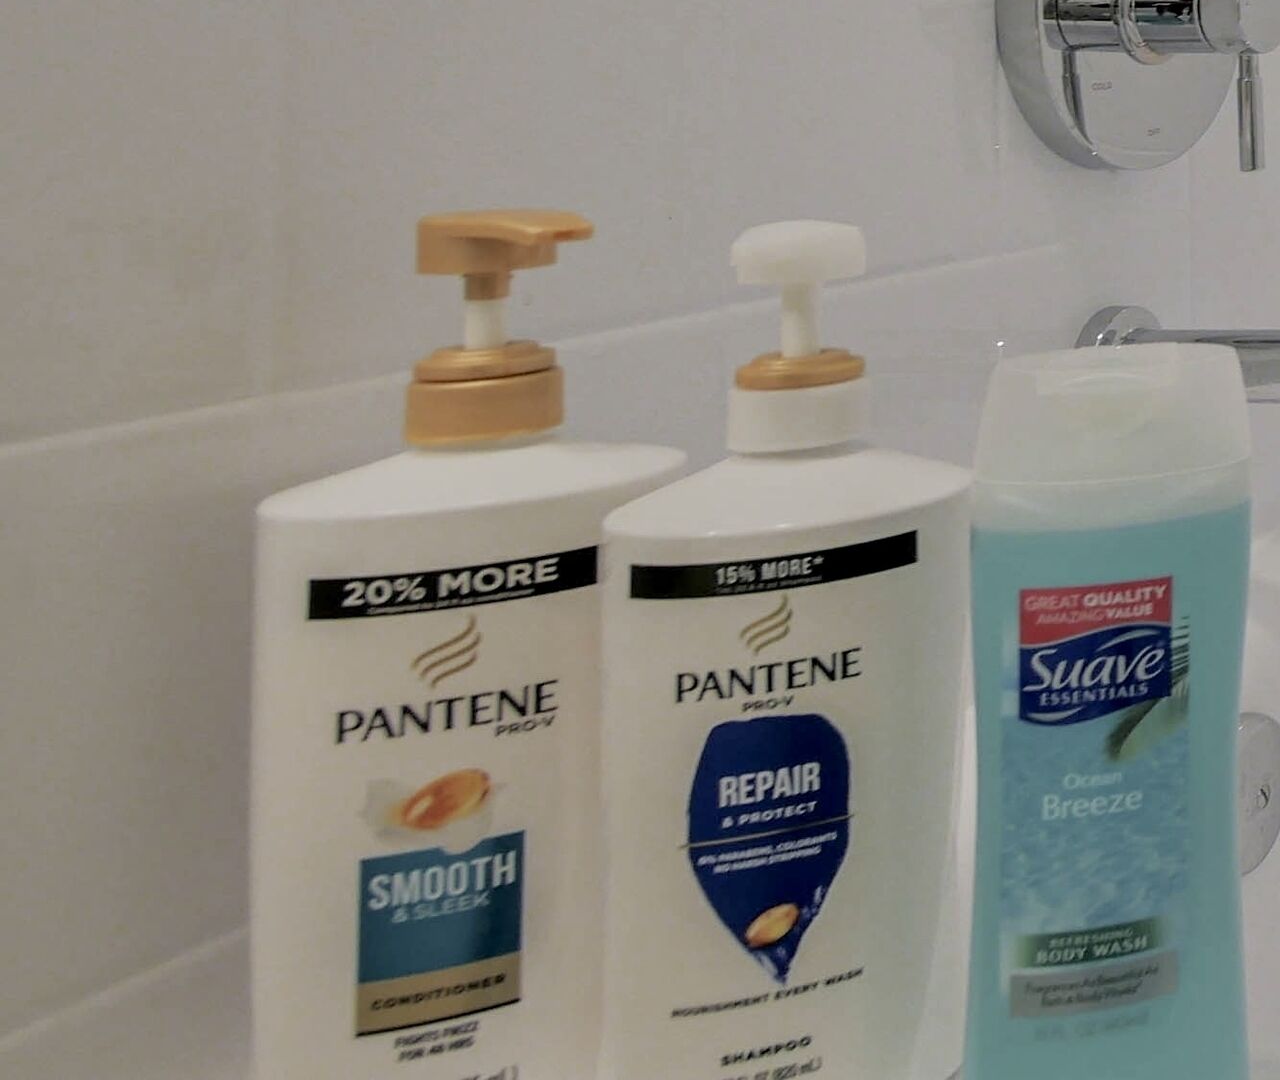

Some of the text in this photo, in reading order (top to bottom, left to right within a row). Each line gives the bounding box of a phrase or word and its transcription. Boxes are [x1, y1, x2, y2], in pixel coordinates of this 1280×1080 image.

[341, 575, 427, 608] 20%
[437, 557, 560, 598] MORE
[716, 564, 756, 585] 15%
[1025, 584, 1168, 611] GREAT QUALITY
[1036, 603, 1153, 624] AMAZING VALUE
[675, 647, 863, 703] PANTENE
[1022, 645, 1166, 691] Suave
[741, 695, 795, 712] PRO-V
[1040, 683, 1149, 706] ESSENTIALS
[335, 680, 558, 745] PANTENE
[495, 716, 555, 737] PRO-V
[718, 761, 821, 808] REPAIR
[1063, 772, 1123, 789] Ocean
[737, 801, 818, 826] PROTECT
[1042, 791, 1143, 821] Breeze
[366, 850, 517, 910] SMOOTH
[391, 891, 491, 924] & SLEEK
[1036, 935, 1149, 964] BODY WASH
[369, 973, 507, 1011] CONDITIONER
[774, 981, 819, 1001] EVERY
[721, 1035, 813, 1067] SHAMPOO
